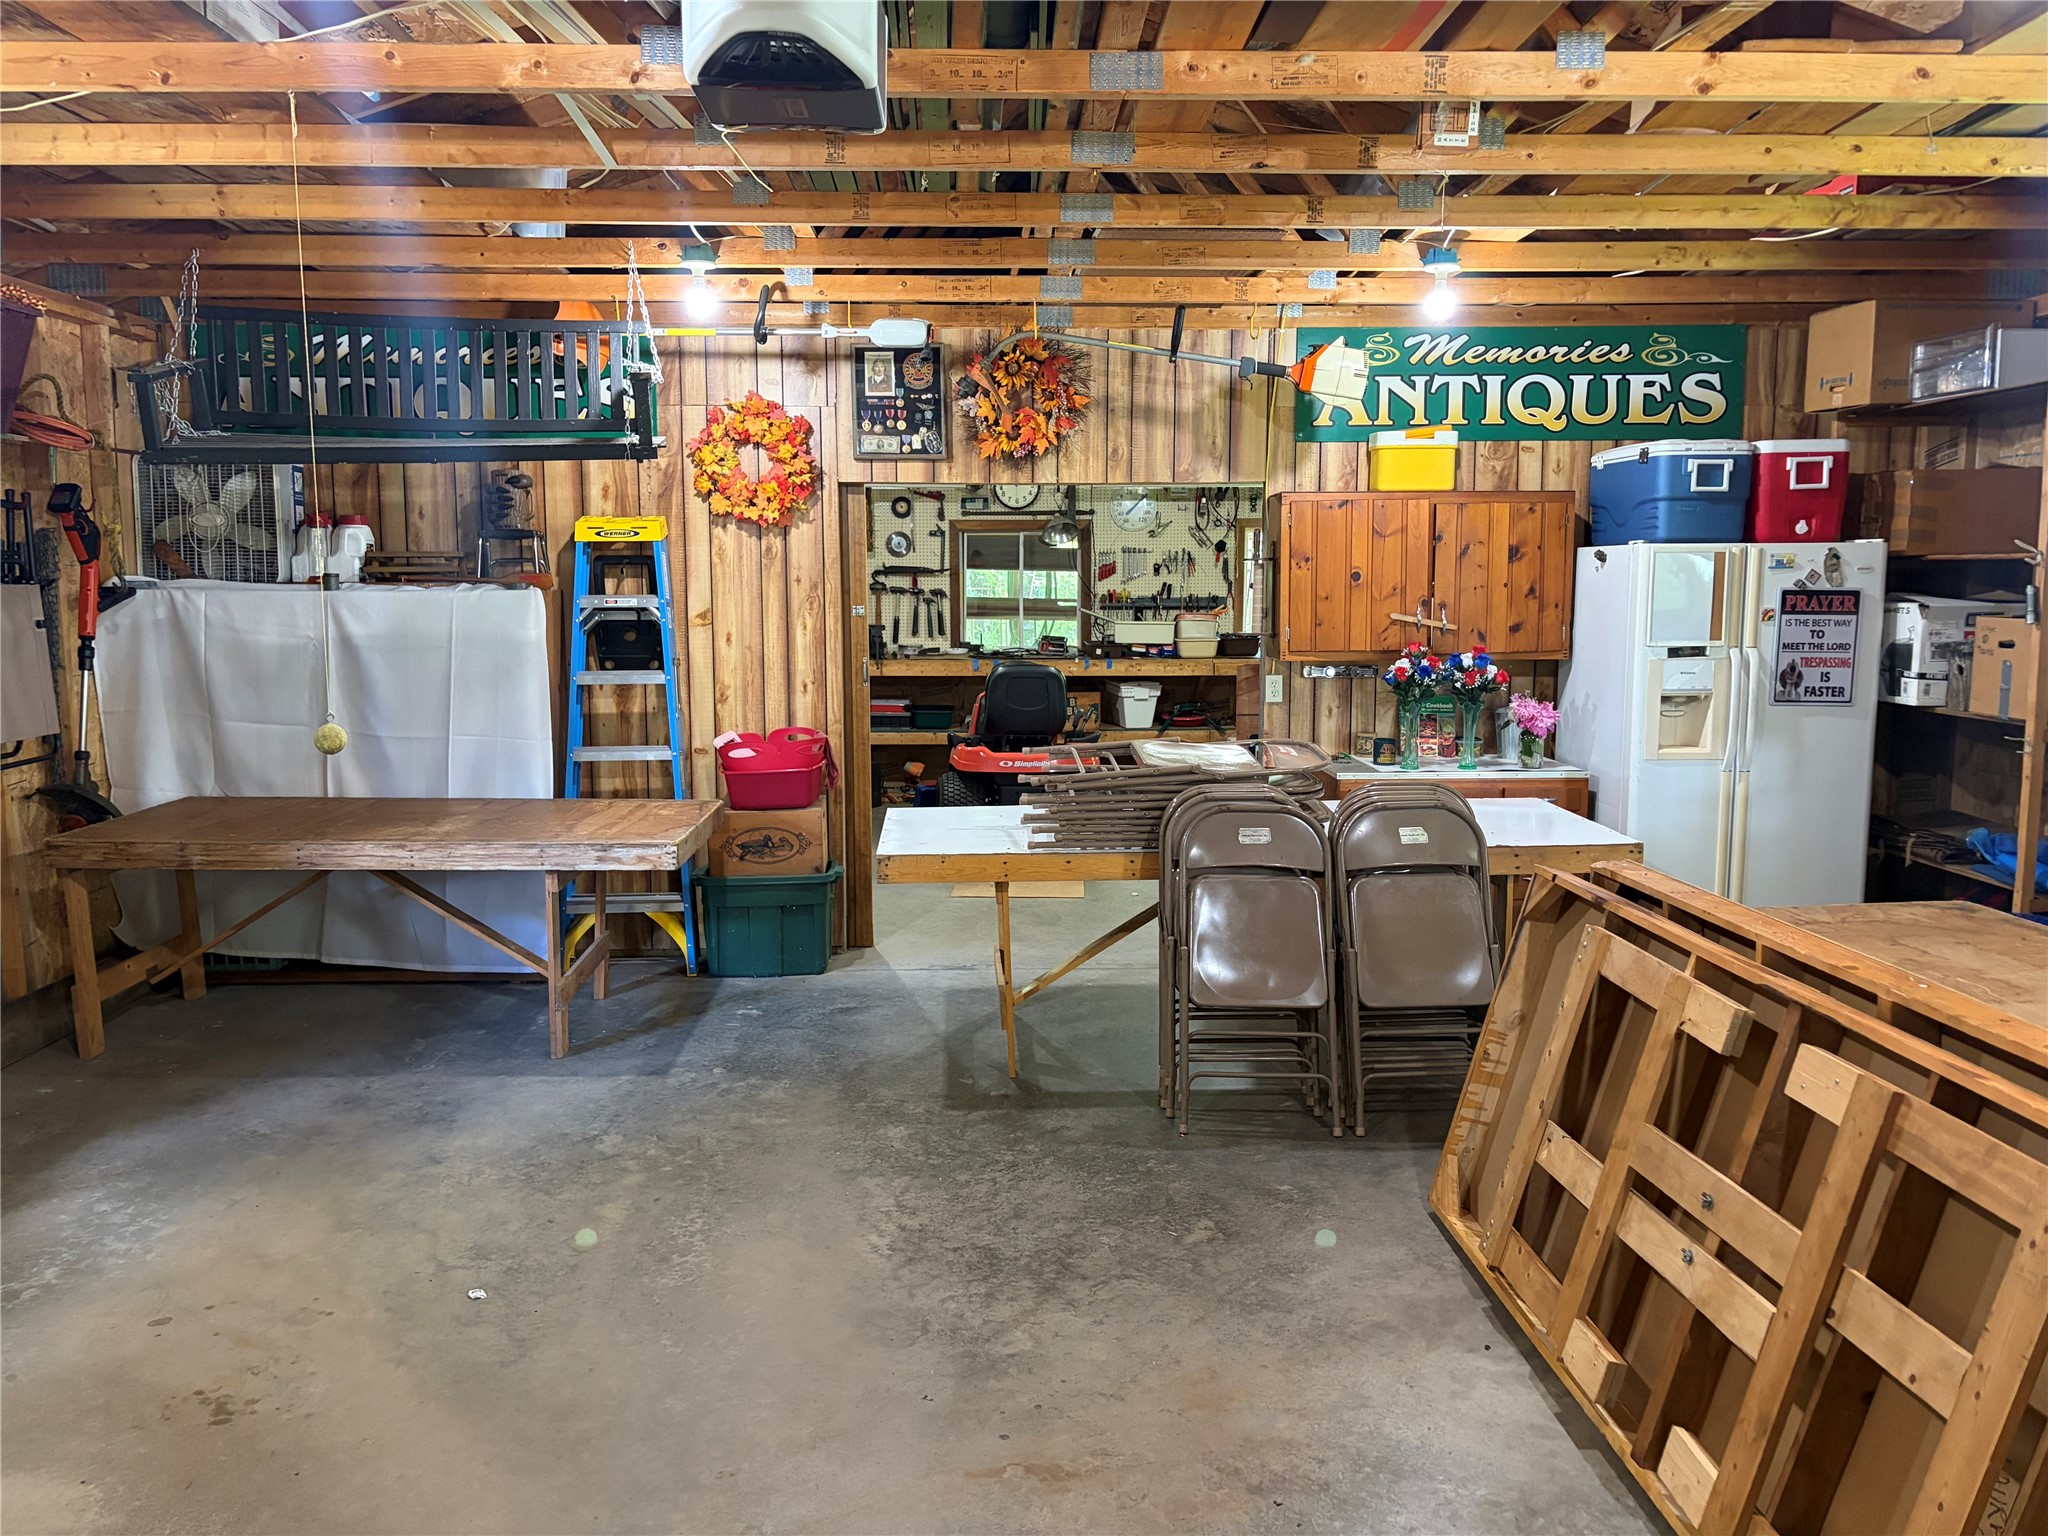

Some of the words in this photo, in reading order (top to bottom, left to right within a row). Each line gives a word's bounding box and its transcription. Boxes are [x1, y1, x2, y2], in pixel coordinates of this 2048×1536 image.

[1404, 333, 1635, 366] Memories
[1784, 594, 1856, 612] PRAYER
[1785, 618, 1793, 626] IS
[1794, 618, 1811, 627] THE
[1812, 618, 1833, 627] BEST
[1834, 618, 1852, 627] WAY
[1810, 630, 1825, 639] TO
[1782, 642, 1806, 650] MEET
[1808, 642, 1825, 650] THE
[1826, 642, 1852, 650] LORD
[1800, 656, 1852, 668] TRESPASSING
[1820, 672, 1830, 682] IS
[1804, 686, 1845, 698] FASTER
